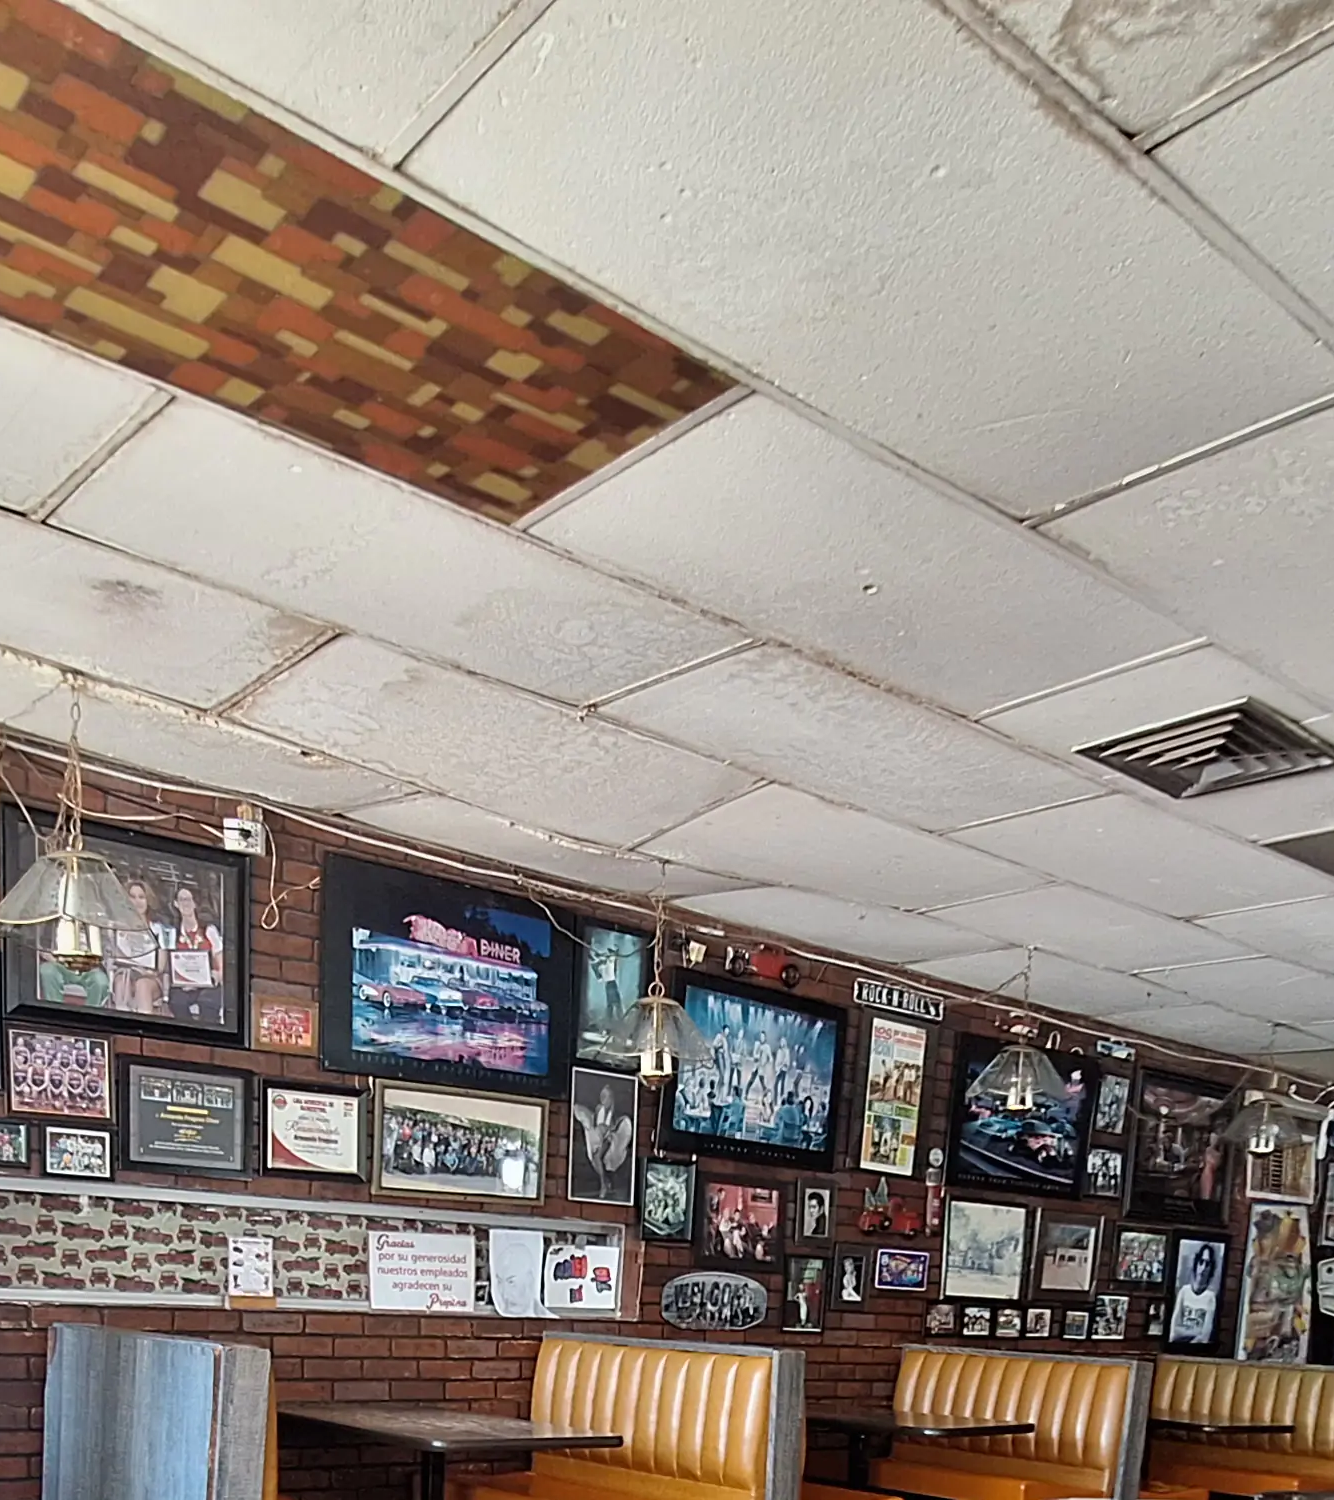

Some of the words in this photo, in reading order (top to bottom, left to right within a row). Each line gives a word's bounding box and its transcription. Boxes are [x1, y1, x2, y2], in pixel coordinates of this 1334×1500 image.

[479, 938, 521, 964] DINER
[862, 983, 927, 1014] ROCK-N-ROLL
[376, 1233, 416, 1251] Gracias
[378, 1253, 395, 1263] por
[397, 1253, 408, 1261] su
[411, 1253, 467, 1265] generosidad
[377, 1266, 418, 1277] nuestros
[420, 1267, 468, 1279] empleados
[392, 1281, 440, 1292] agradecen
[442, 1283, 453, 1292] su
[425, 1292, 468, 1310] Propina
